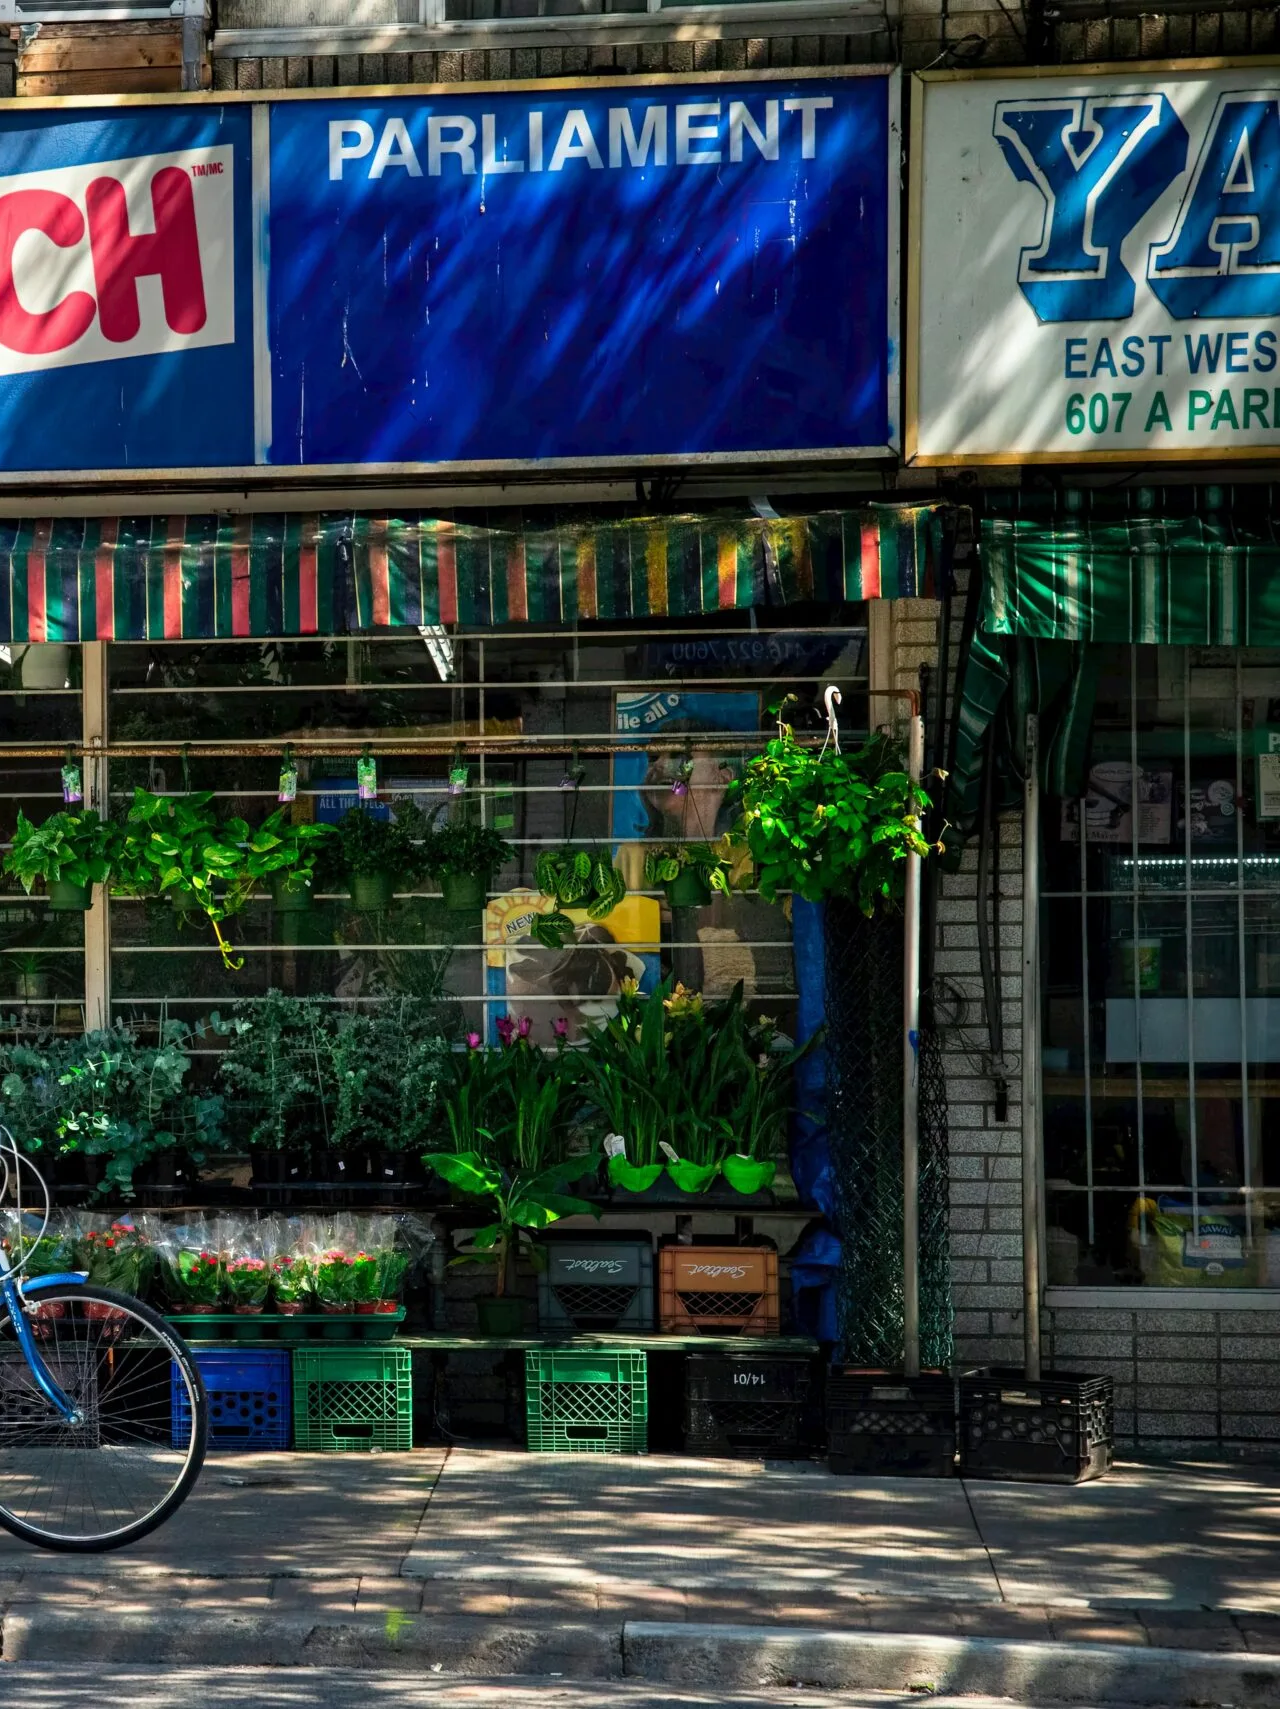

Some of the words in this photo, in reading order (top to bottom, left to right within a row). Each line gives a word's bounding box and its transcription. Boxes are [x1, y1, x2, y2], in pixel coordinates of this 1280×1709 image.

[328, 97, 834, 180] PARLIAMENT
[191, 162, 224, 177] TM/MC
[1064, 334, 1172, 379] EAST
[1065, 391, 1132, 435] 607
[1144, 389, 1172, 432] A
[644, 700, 669, 725] all
[319, 797, 337, 809] ALL
[558, 1258, 629, 1274] Sealtest
[681, 1263, 754, 1279] Sealtest
[733, 1372, 766, 1386] 14/01
